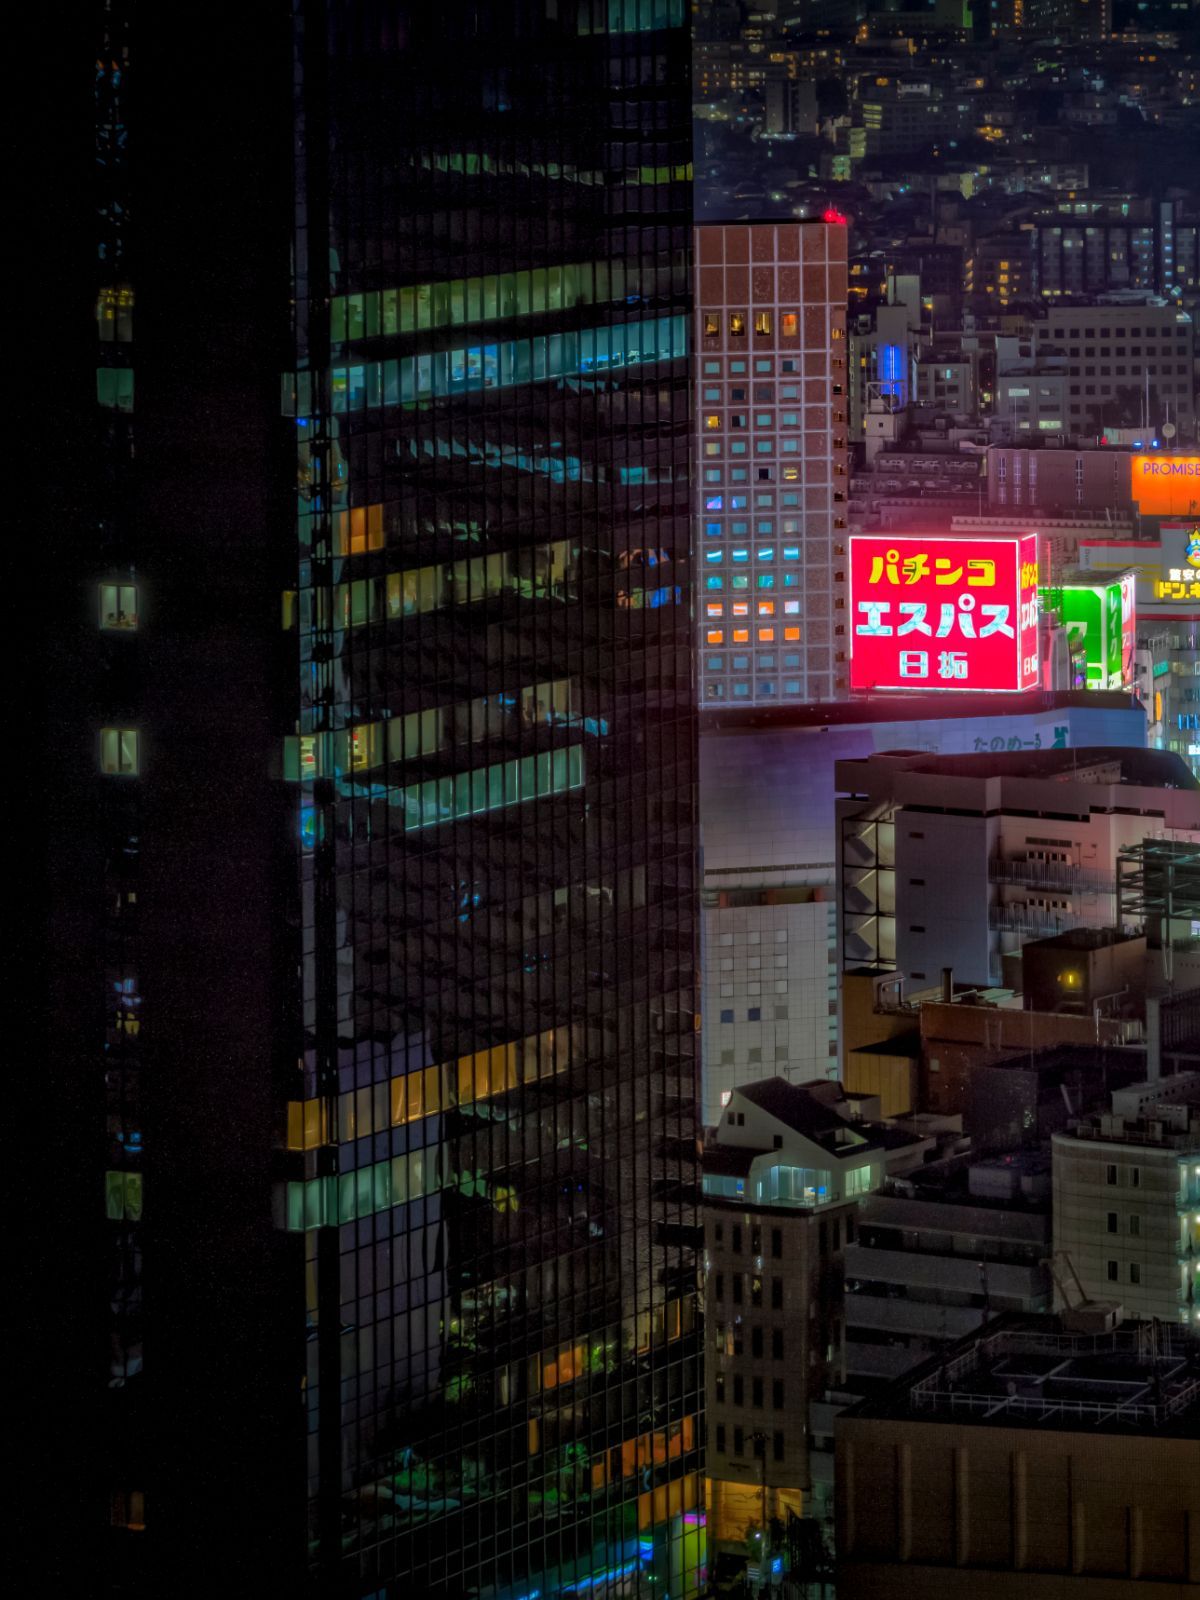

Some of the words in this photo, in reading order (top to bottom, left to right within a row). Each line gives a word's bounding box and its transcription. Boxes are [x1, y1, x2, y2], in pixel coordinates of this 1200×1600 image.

[868, 549, 996, 587] パチンコ
[856, 593, 1015, 639] エスパス
[974, 732, 1042, 753] たのめーる
